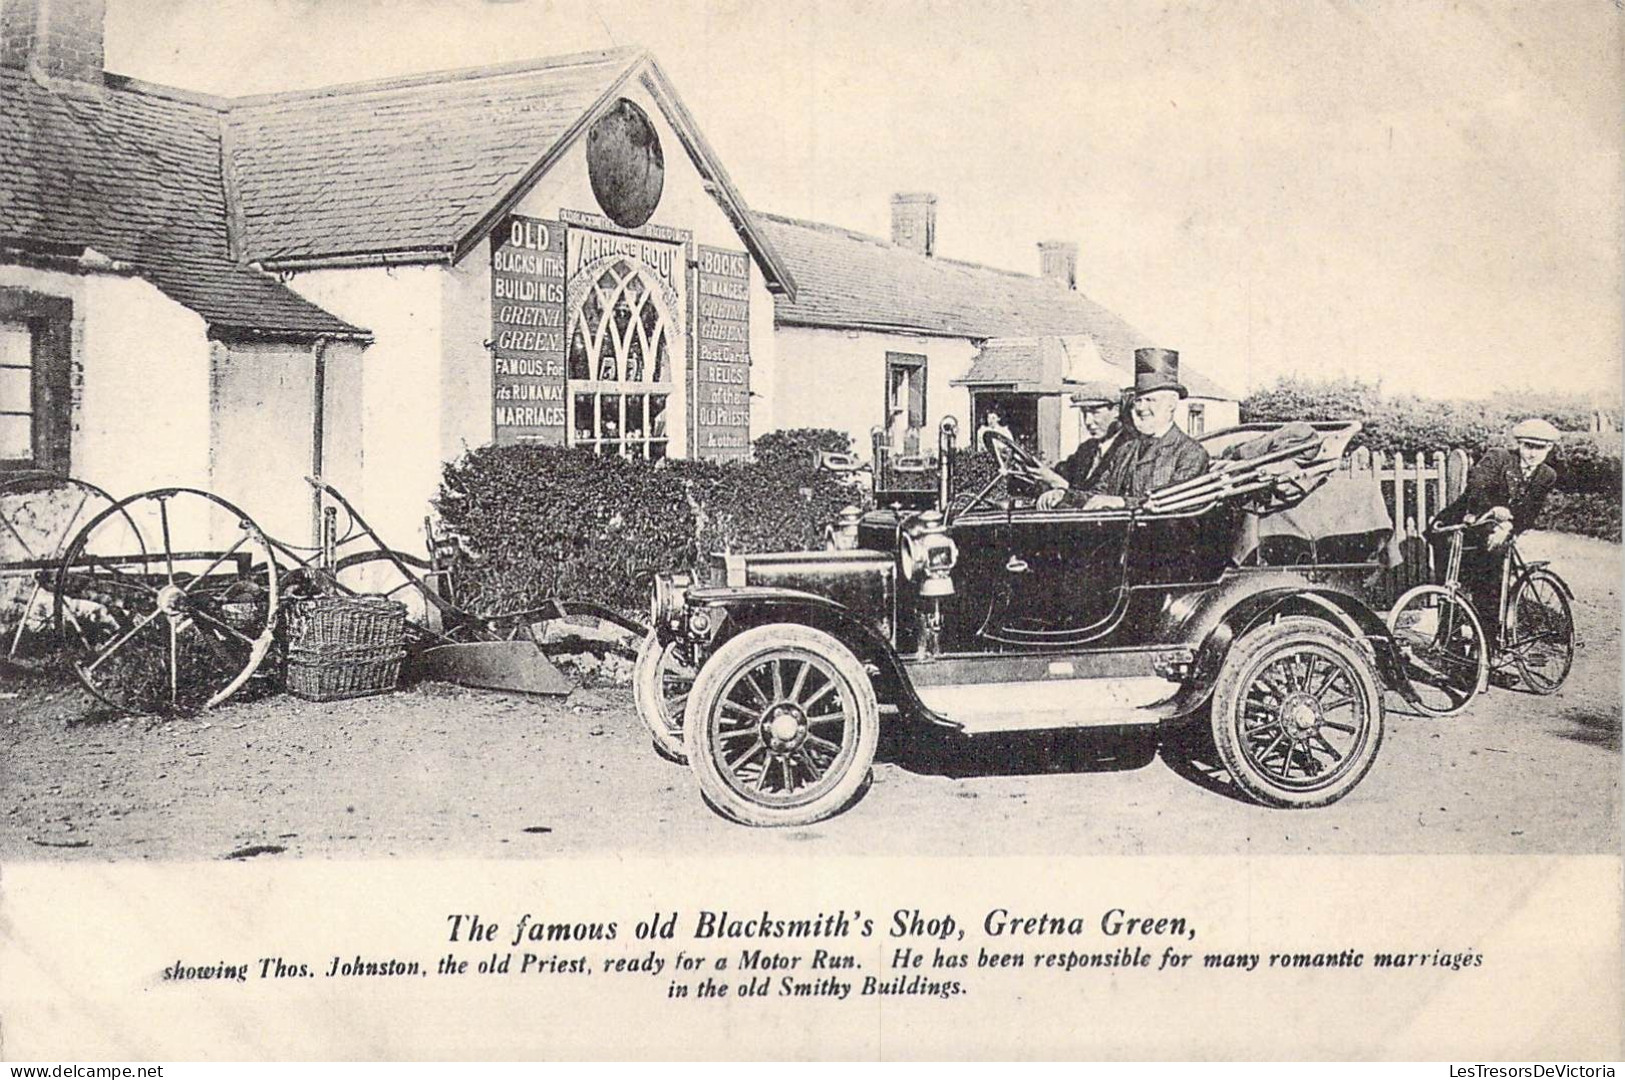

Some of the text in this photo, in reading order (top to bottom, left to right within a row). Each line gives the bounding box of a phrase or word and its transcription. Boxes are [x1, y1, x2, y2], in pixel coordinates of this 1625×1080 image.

[511, 220, 549, 251] OLD
[705, 251, 746, 277] BOOKS
[495, 278, 564, 303] BUILDINGS
[500, 305, 563, 326] GRETNA
[701, 344, 721, 361] Post
[709, 366, 743, 384] RELICS
[496, 384, 564, 401] its RUNAWAY
[711, 387, 723, 404] of
[496, 406, 565, 426] MARRIAGES
[700, 407, 716, 426] OLD
